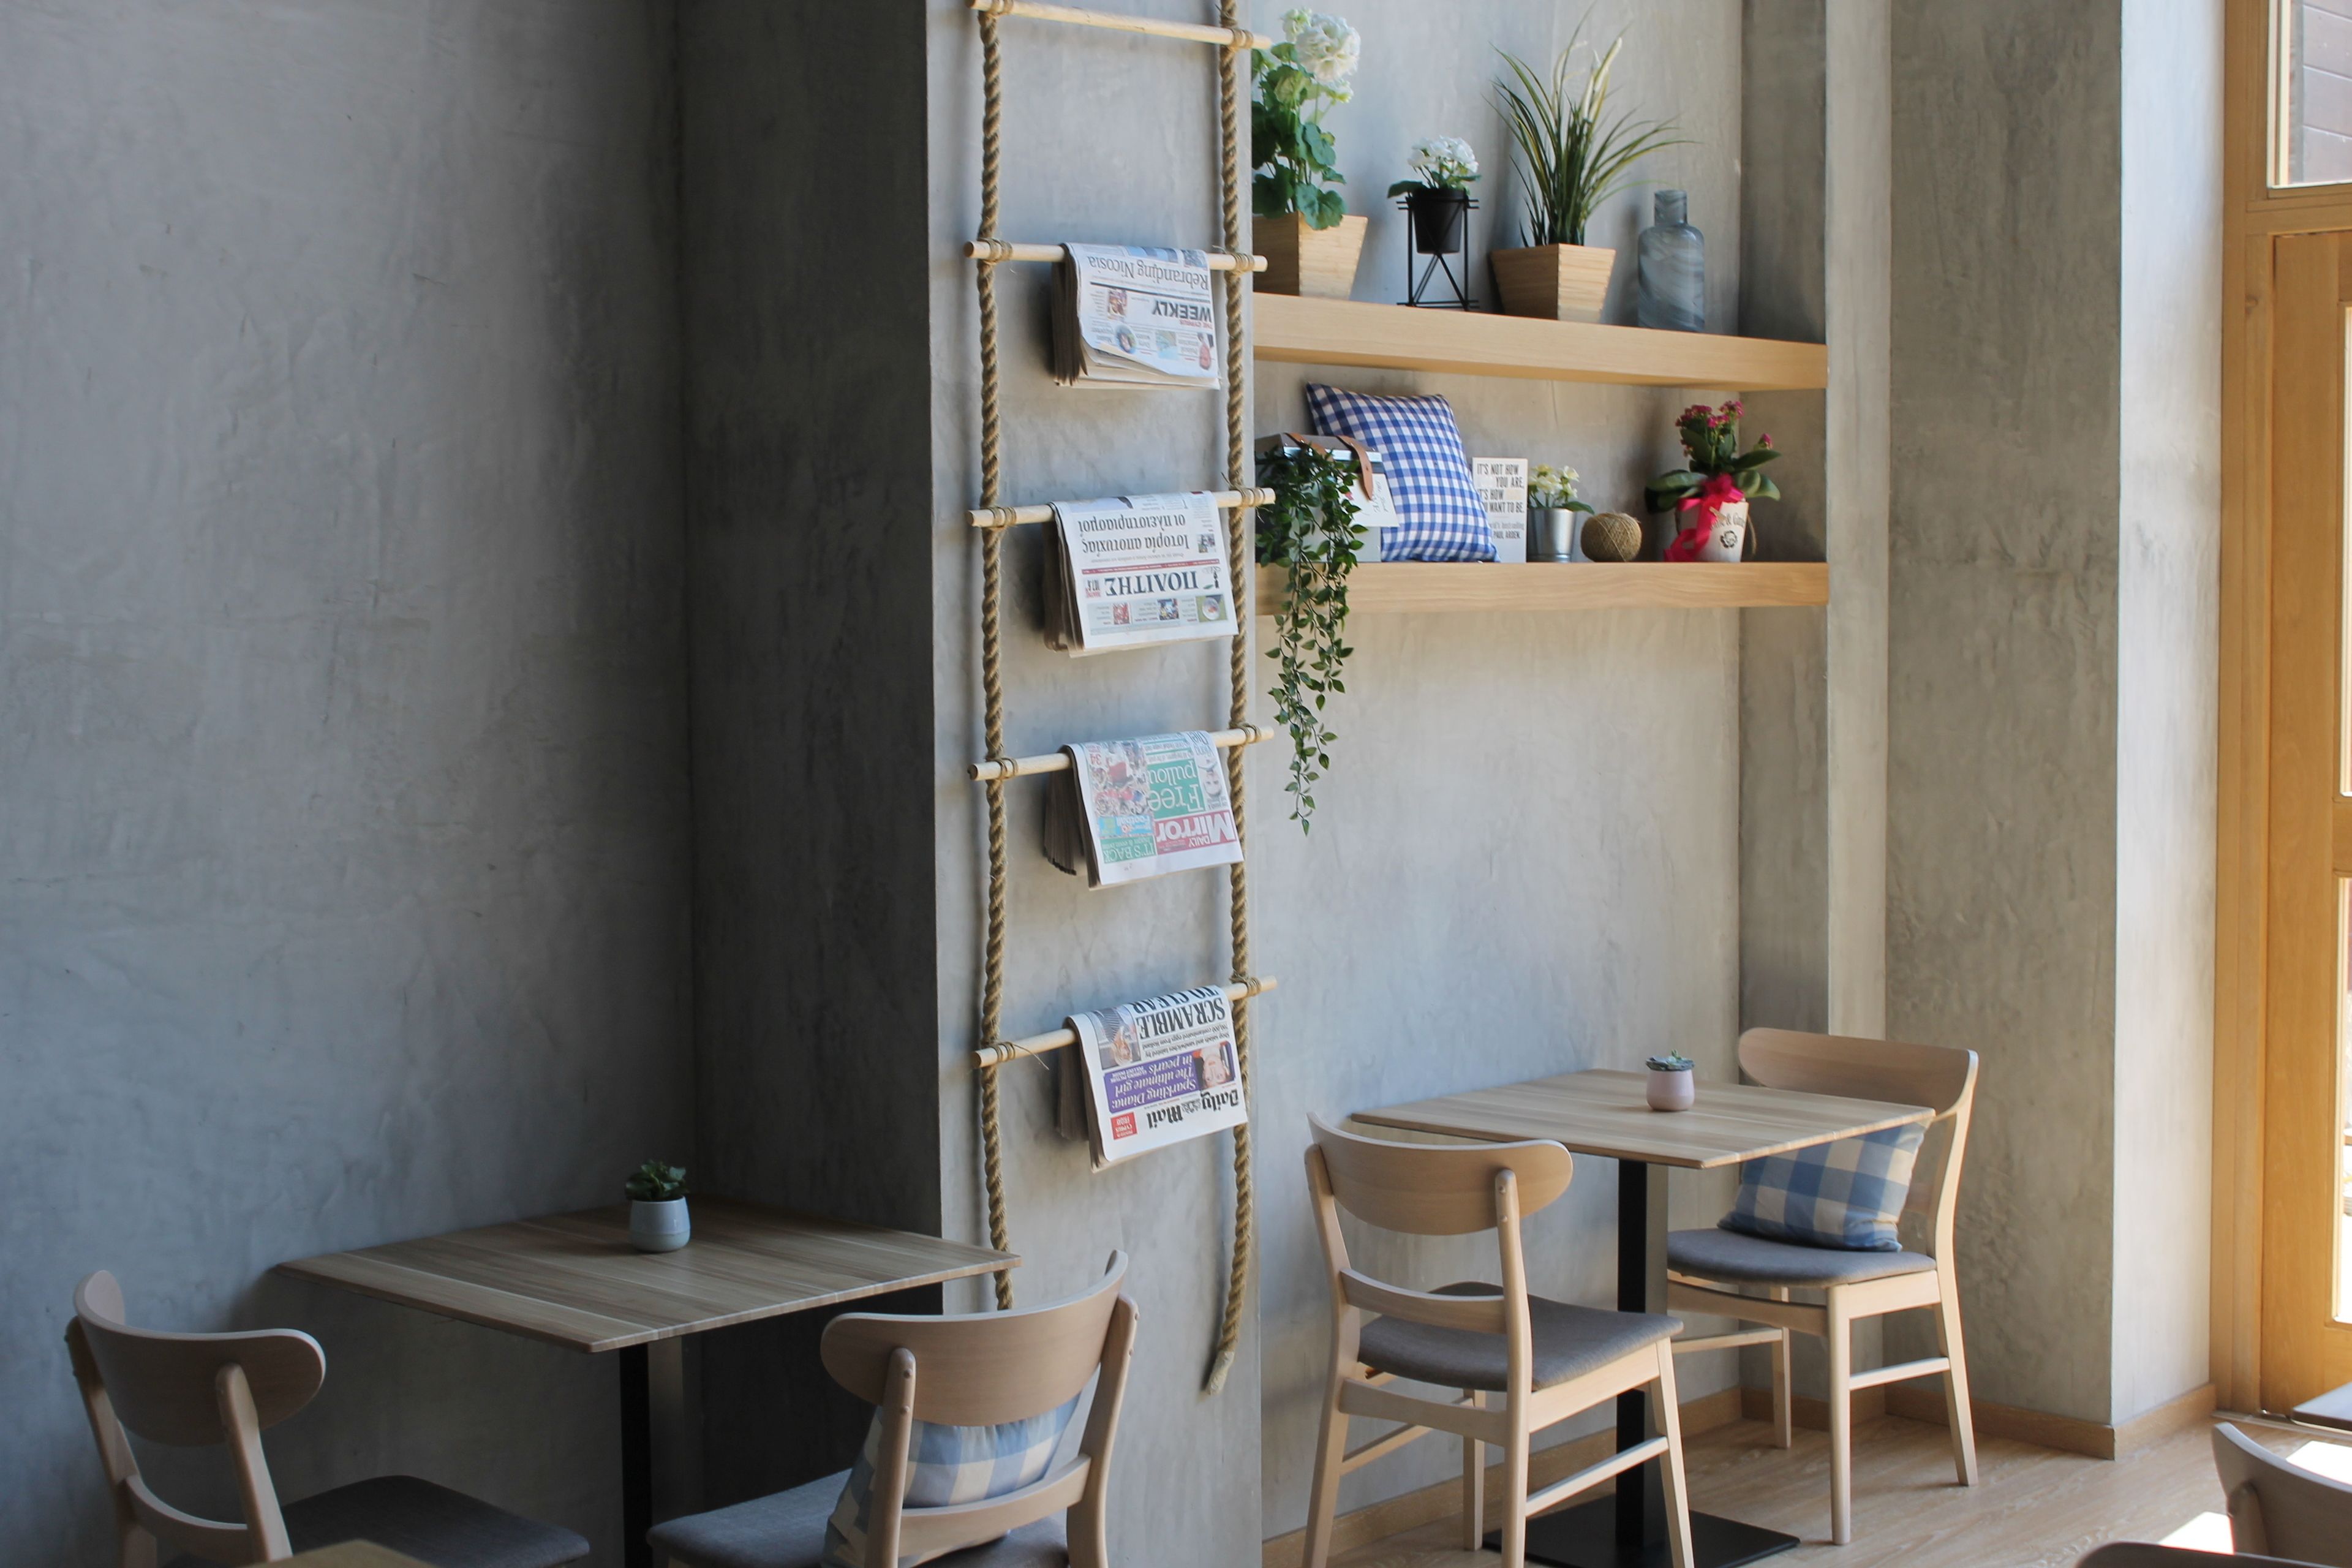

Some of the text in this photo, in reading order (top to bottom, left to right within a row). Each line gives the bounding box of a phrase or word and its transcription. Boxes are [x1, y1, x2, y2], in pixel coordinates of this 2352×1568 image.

[1087, 256, 1134, 279] Nicosia
[1136, 260, 1208, 290] Rebranding
[1152, 300, 1212, 322] WEEKLY
[1477, 463, 1519, 475] IT'S NOT HOW
[1496, 477, 1508, 488] YOU
[1490, 489, 1504, 500] HOW
[1489, 502, 1506, 513] WANT
[1507, 502, 1514, 513] TO
[1077, 513, 1171, 537] πλειστηριασμοί
[1174, 514, 1185, 526] οι
[1081, 533, 1189, 557] Ιστορία αποτυχίας
[1104, 571, 1198, 597] ΠΟΛΙΤΗΣ
[1147, 784, 1204, 811] Free
[1156, 812, 1236, 843] Mirror
[1134, 843, 1154, 856] IT'S
[1188, 836, 1209, 847] DAILY
[1102, 844, 1133, 862] BACK
[1135, 997, 1225, 1039] SCRAMBLE
[1142, 1041, 1159, 1050] Holland
[1169, 1041, 1195, 1051] sandwiches
[1148, 1055, 1192, 1076] in pearls
[1115, 1066, 1193, 1097] The ultimate girl
[1147, 1078, 1196, 1101] Sparkling
[1112, 1093, 1145, 1109] Diana:
[1200, 1090, 1238, 1111] Daily
[1147, 1105, 1183, 1129] Mail
